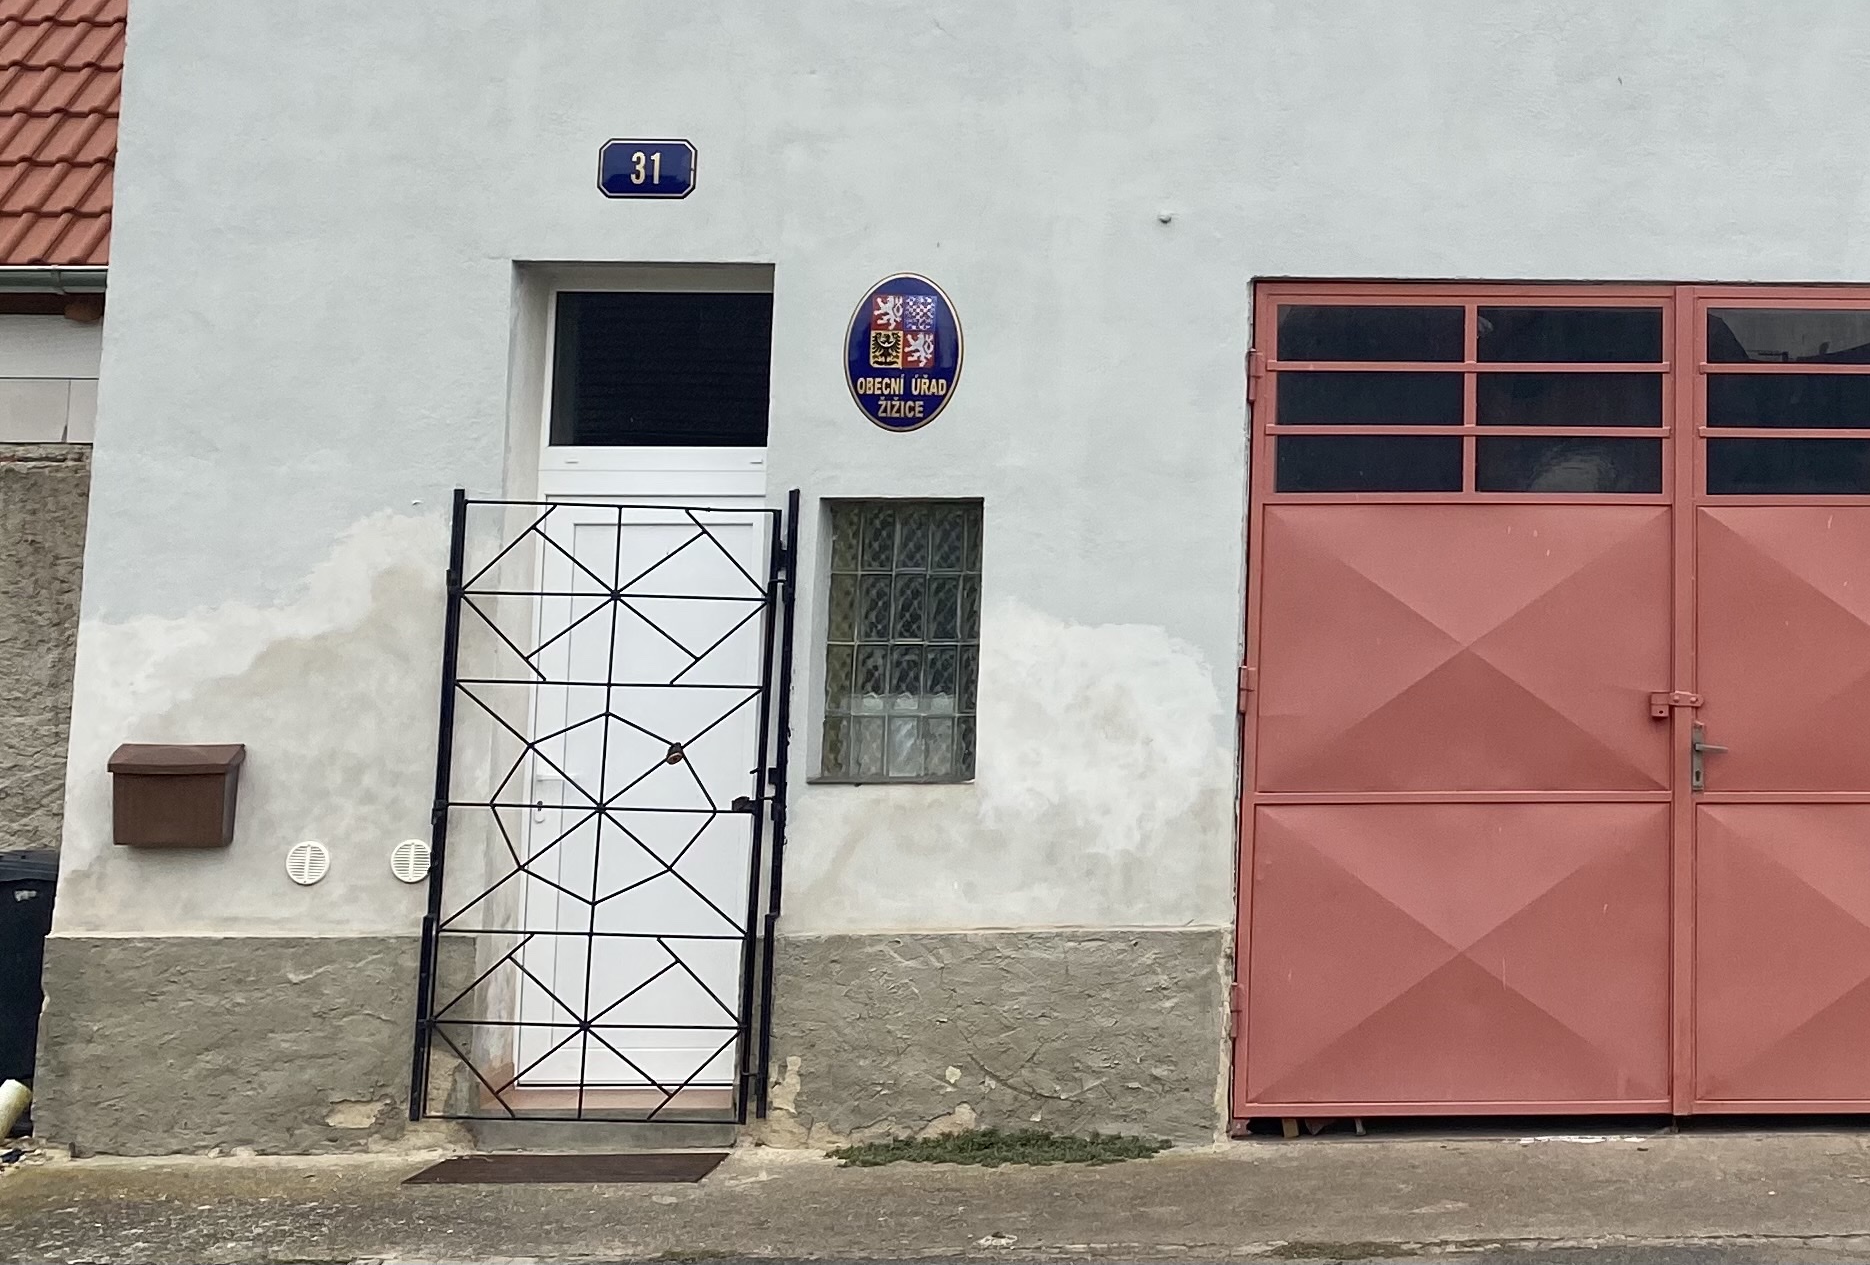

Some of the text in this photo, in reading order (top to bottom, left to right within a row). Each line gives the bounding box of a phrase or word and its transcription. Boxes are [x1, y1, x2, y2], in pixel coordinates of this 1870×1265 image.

[630, 151, 661, 185] 31
[857, 373, 947, 396] OBECNÍ ÚŘAD
[877, 396, 924, 418] ŽIŽICE
